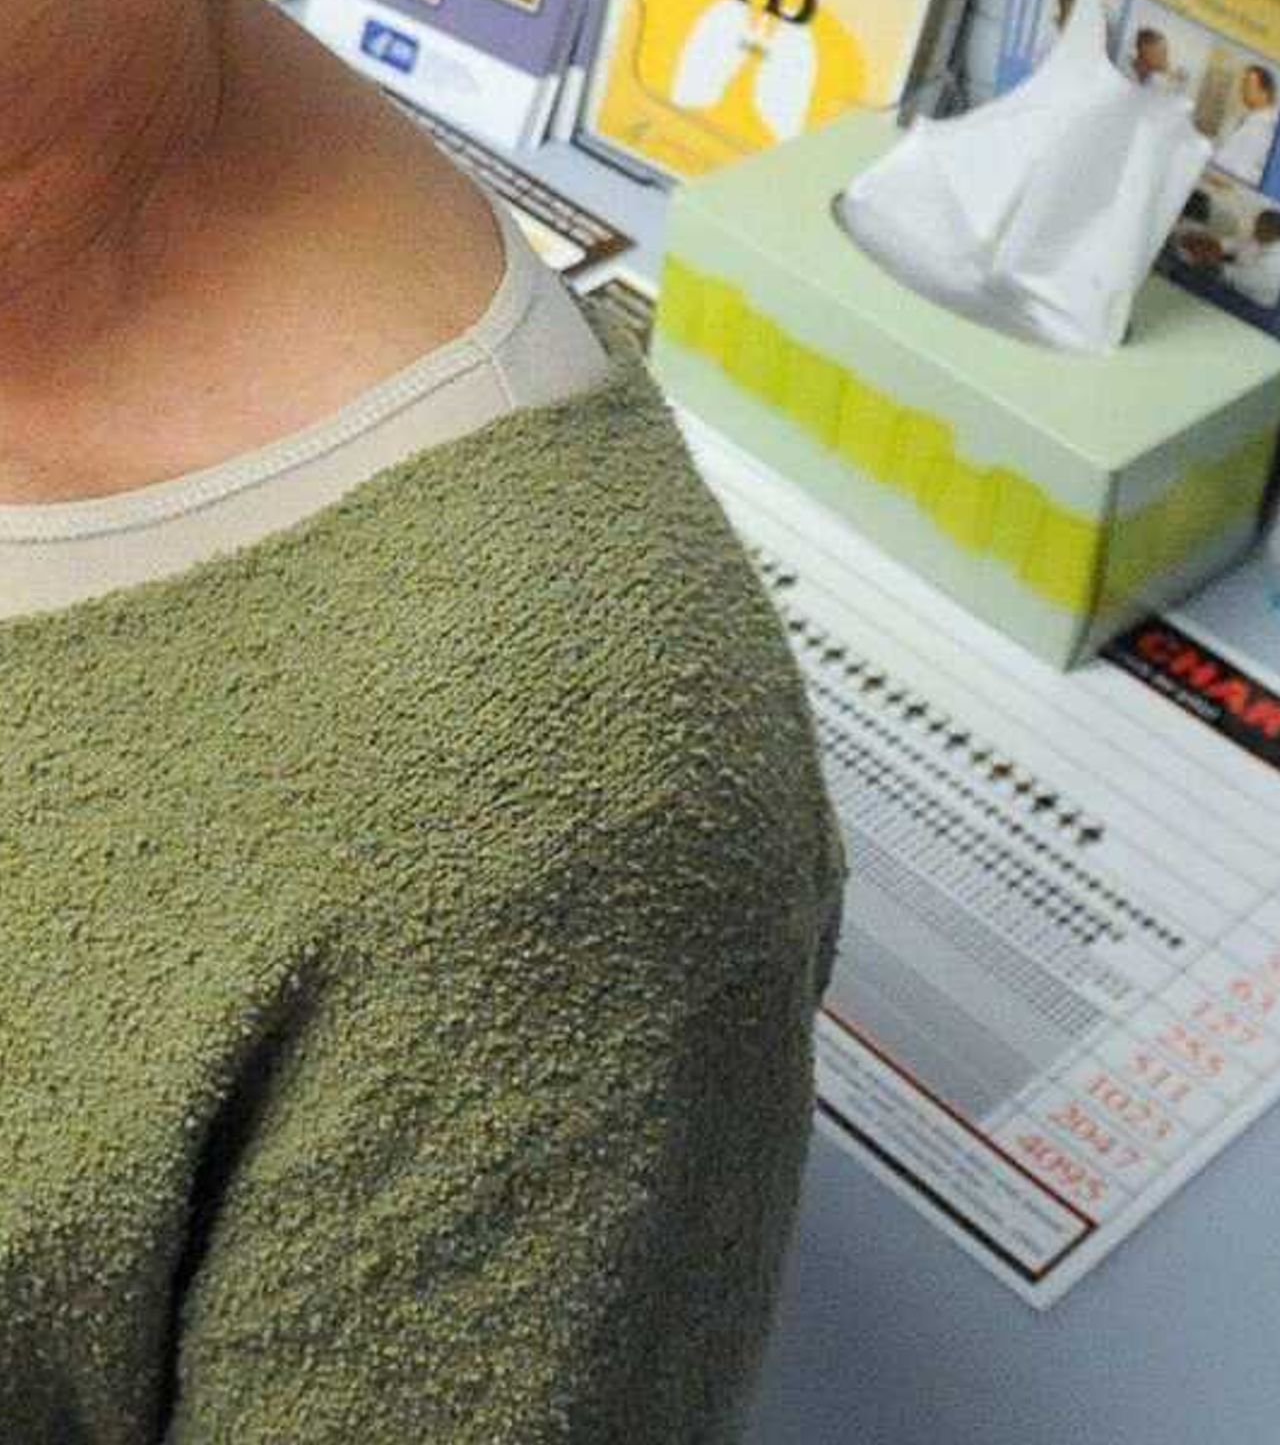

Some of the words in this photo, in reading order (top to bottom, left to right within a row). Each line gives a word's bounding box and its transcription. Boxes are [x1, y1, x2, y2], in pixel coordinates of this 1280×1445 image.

[1047, 1100, 1141, 1170] 2047
[1086, 1070, 1177, 1141] 1023
[1016, 1132, 1108, 1203] 4095
